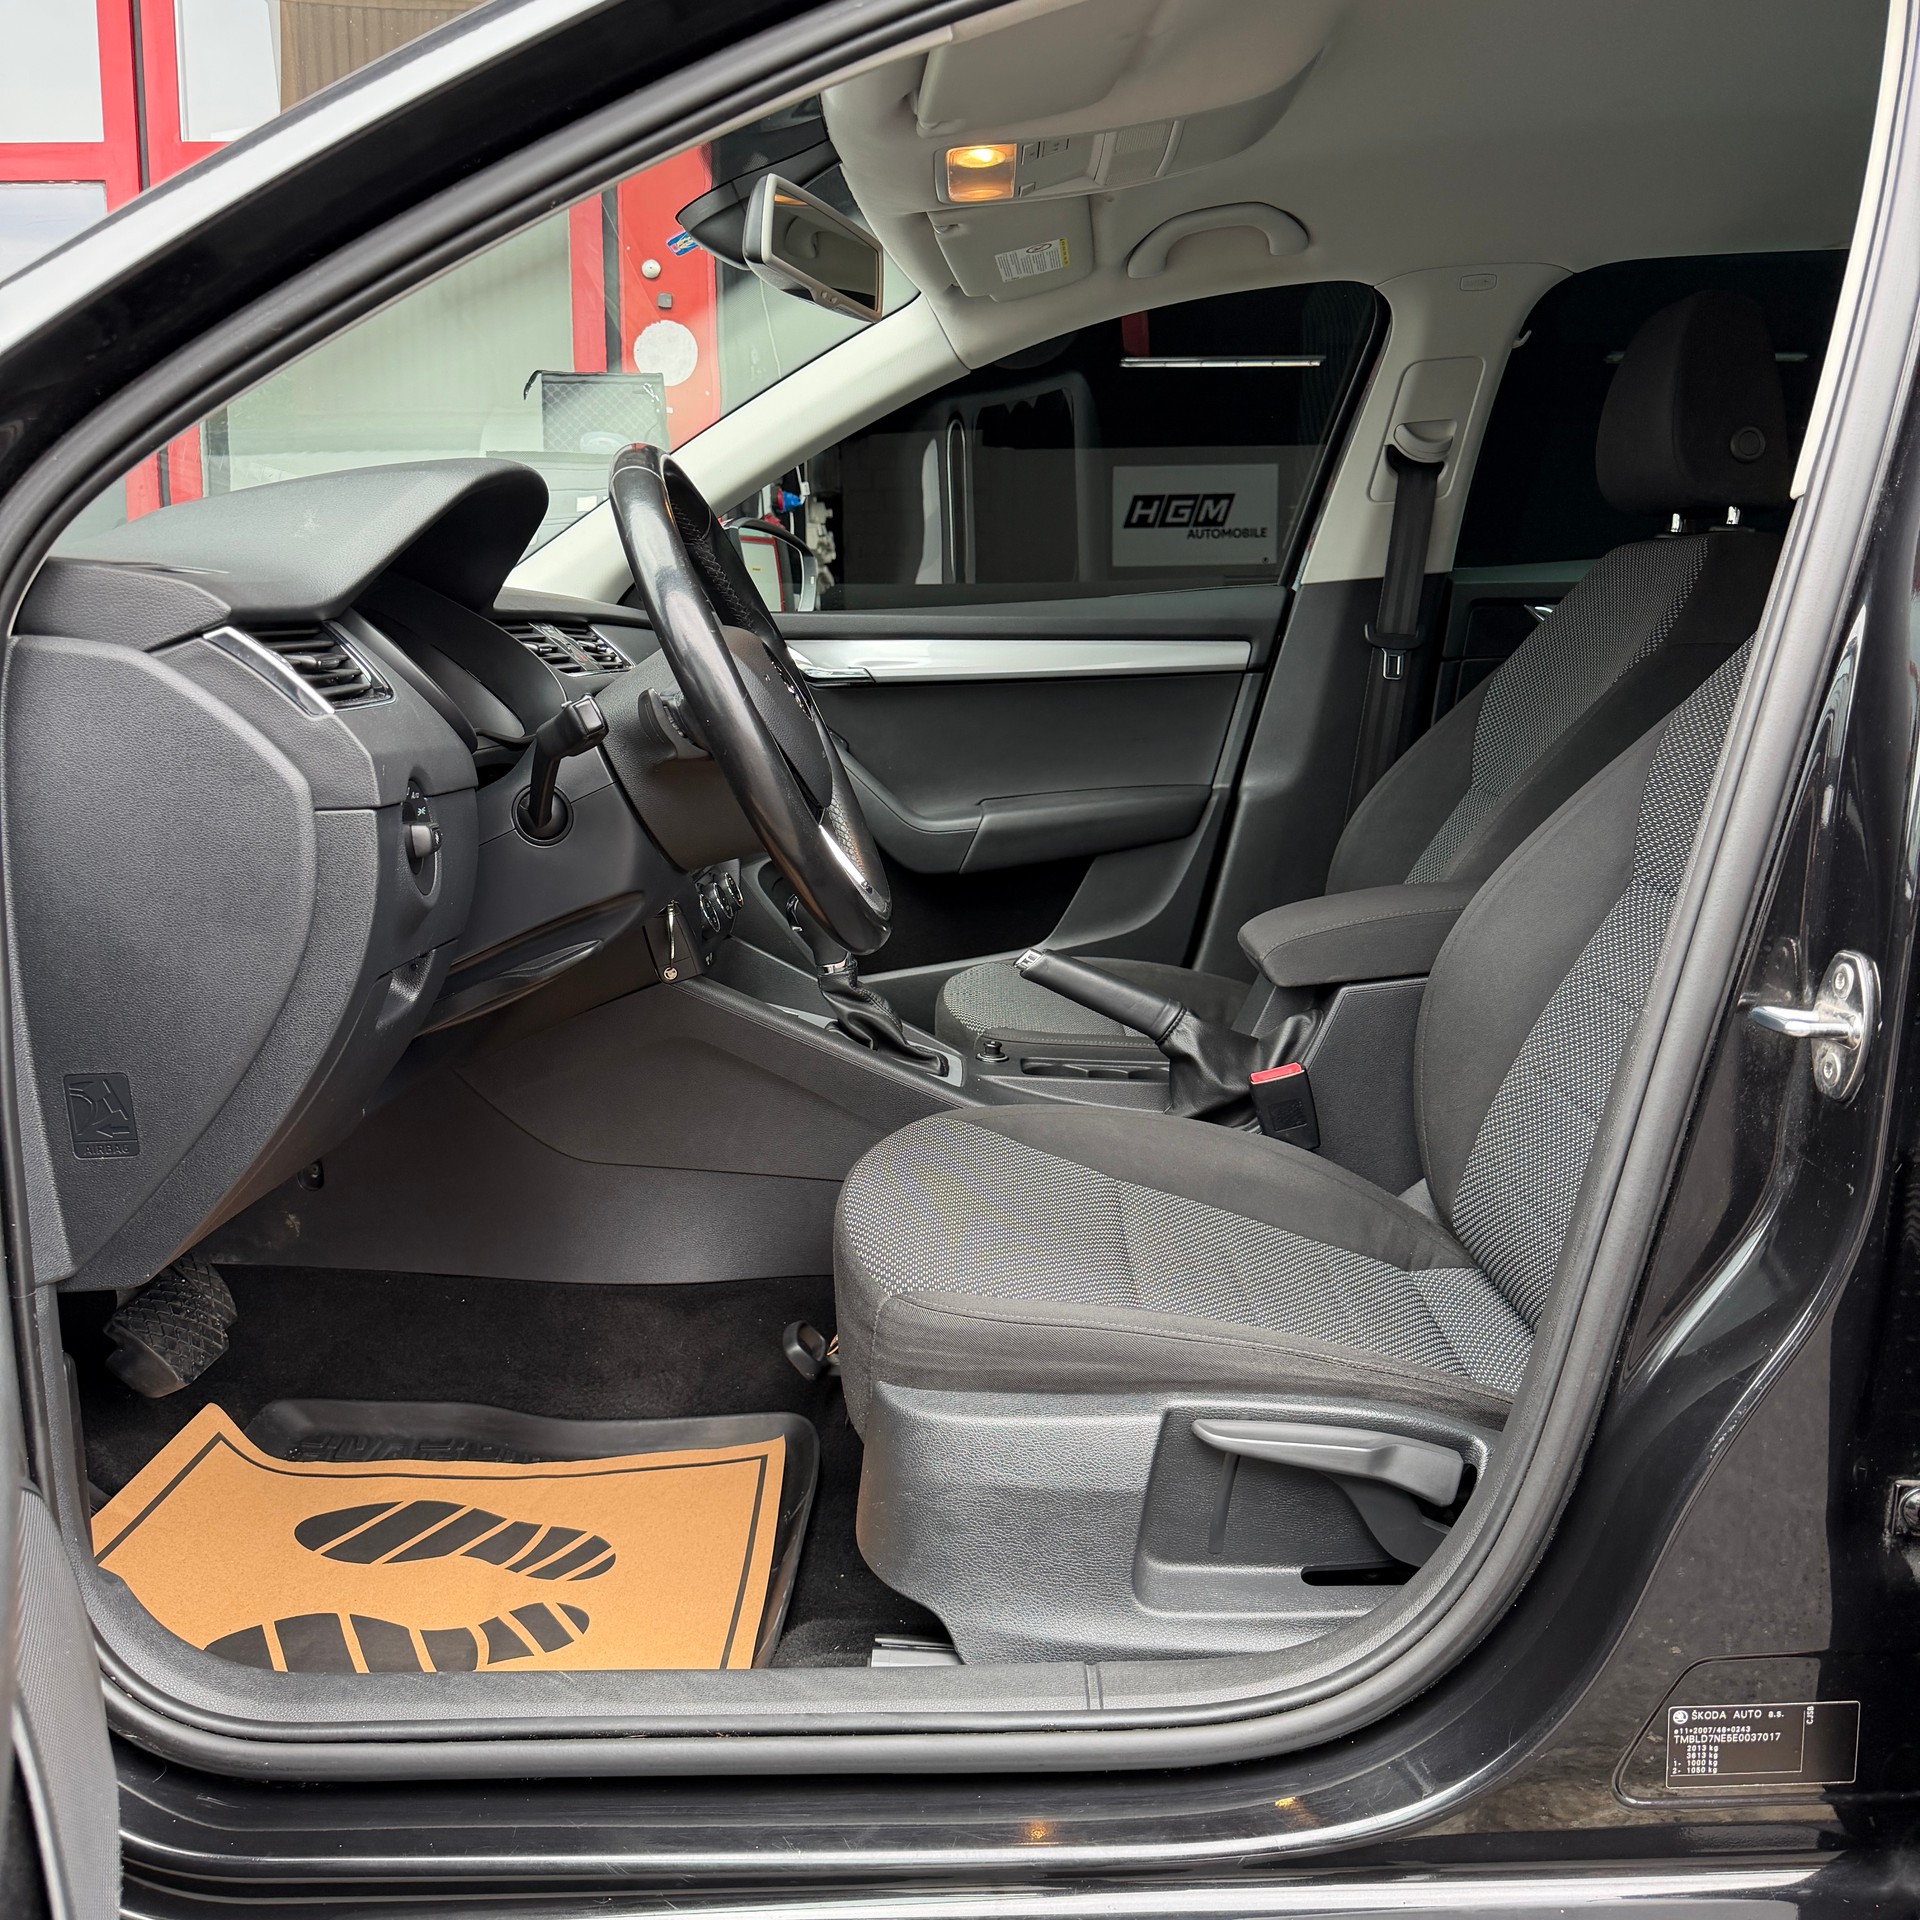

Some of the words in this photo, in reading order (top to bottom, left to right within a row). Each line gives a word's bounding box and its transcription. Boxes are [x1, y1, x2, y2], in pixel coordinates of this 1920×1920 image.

[1127, 496, 1230, 526] HGM
[1186, 527, 1268, 540] AUTOMOBILE
[83, 1144, 131, 1156] AIRBAG
[1691, 1709, 1727, 1720] ŠKODA
[1733, 1709, 1762, 1719] AUTO
[1686, 1744, 1707, 1752] 2013
[1709, 1744, 1719, 1753] kg
[1708, 1752, 1718, 1760] kg
[1686, 1759, 1706, 1767] 1000
[1708, 1759, 1718, 1767] kg
[1686, 1766, 1706, 1774] 1050
[1707, 1766, 1718, 1774] kg
